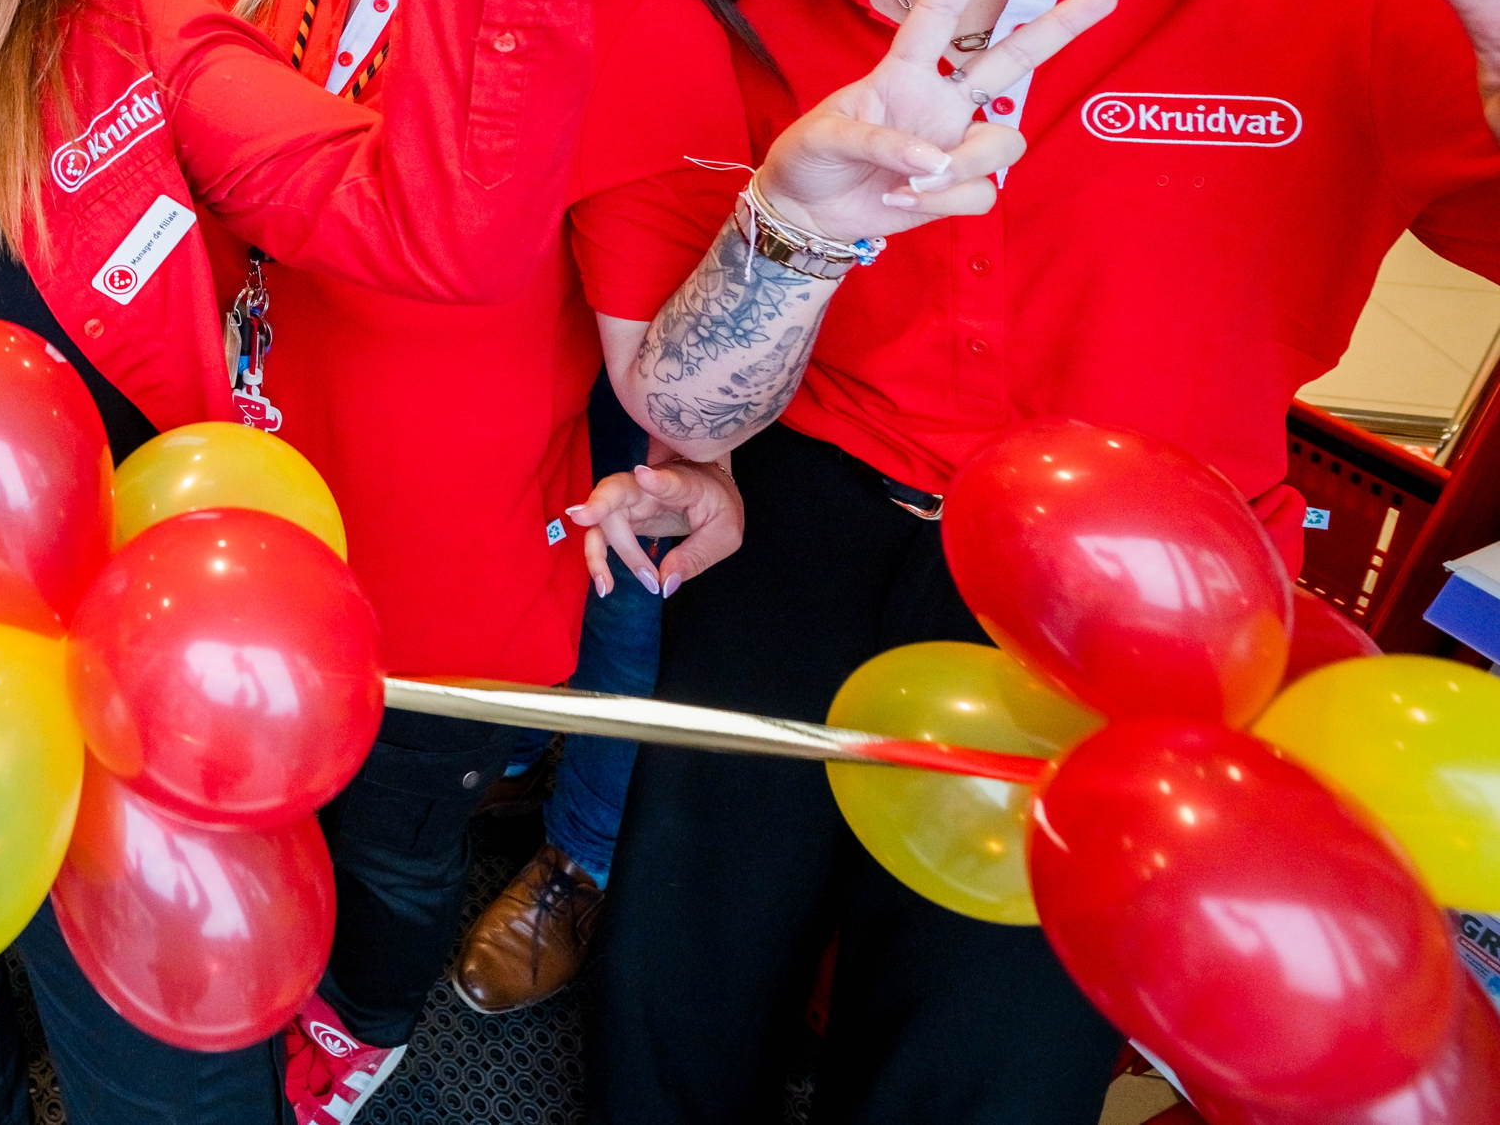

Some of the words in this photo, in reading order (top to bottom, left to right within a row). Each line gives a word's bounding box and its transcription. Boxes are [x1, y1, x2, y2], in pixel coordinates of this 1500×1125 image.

[86, 90, 163, 163] Kruidv
[1138, 103, 1286, 136] Kruidvat
[130, 238, 155, 267] Manager
[153, 229, 164, 241] de
[159, 209, 180, 232] filiale
[1459, 913, 1500, 960] GR
